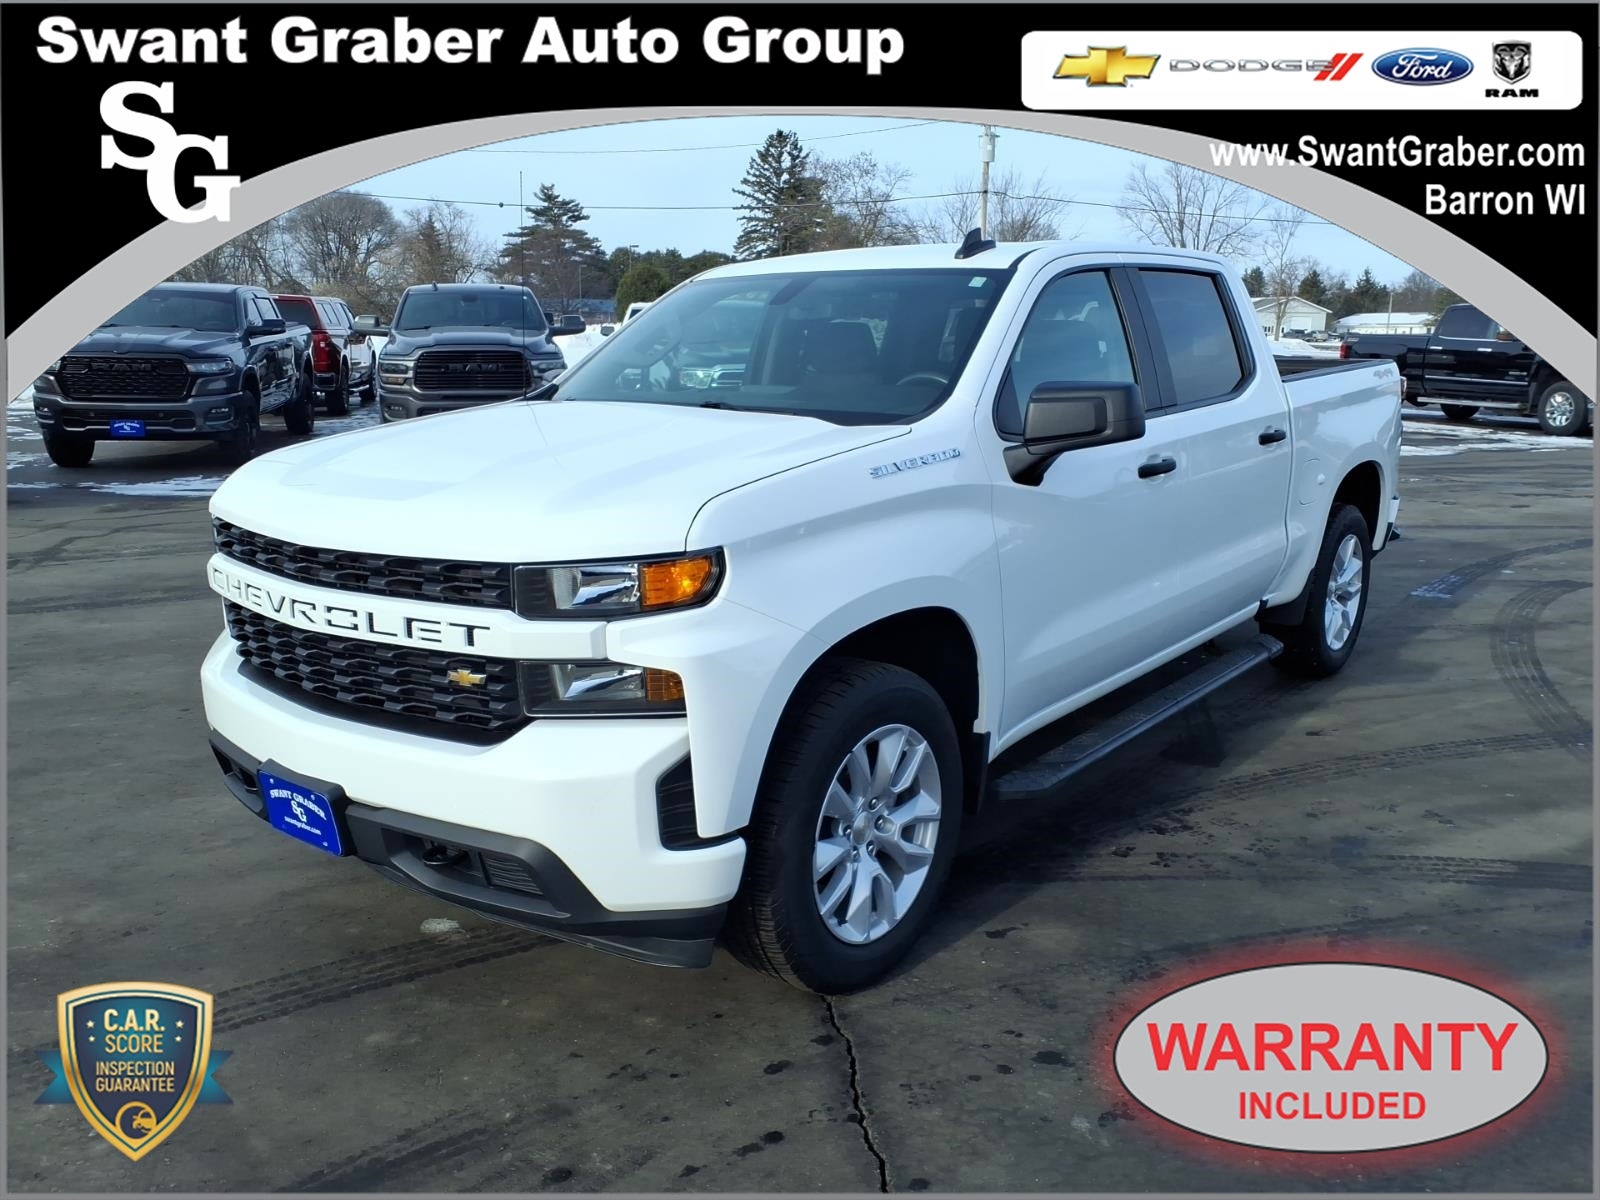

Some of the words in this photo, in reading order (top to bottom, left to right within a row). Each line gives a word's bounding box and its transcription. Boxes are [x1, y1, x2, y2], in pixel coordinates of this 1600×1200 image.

[870, 448, 961, 479] SILVERADO
[210, 567, 491, 648] CHEVROLET
[269, 788, 293, 799] SWANT
[293, 792, 327, 820] GRABER
